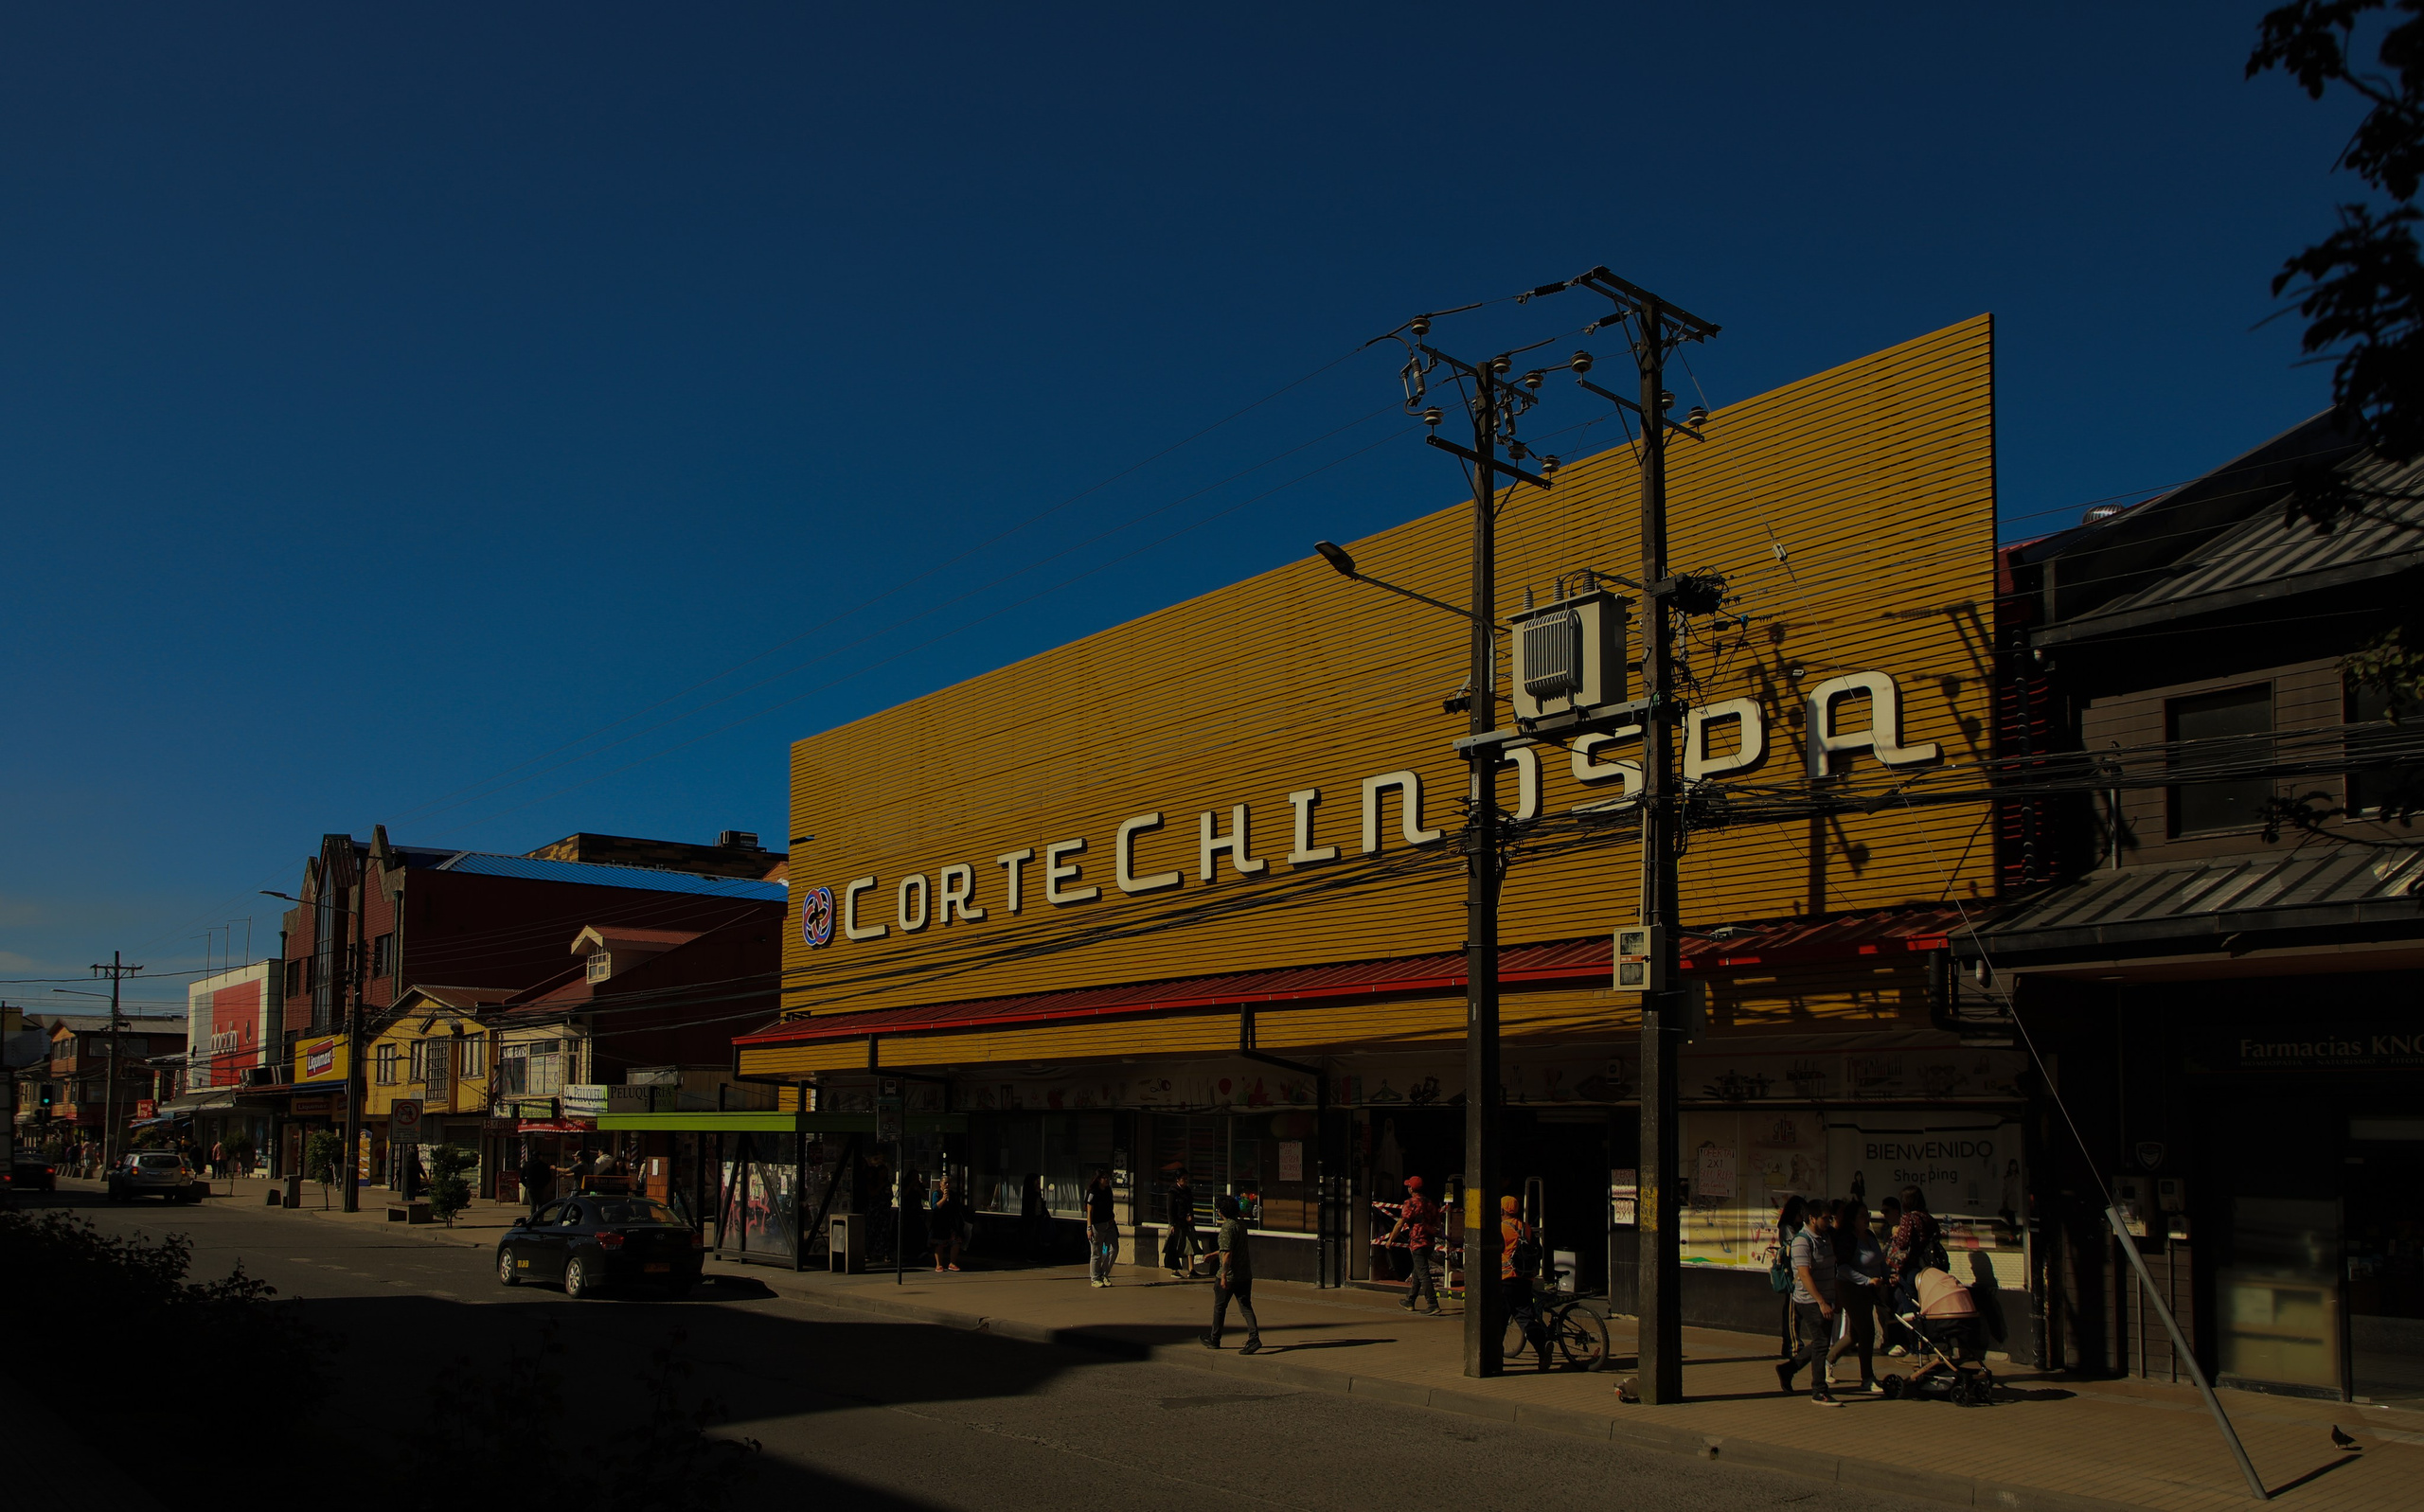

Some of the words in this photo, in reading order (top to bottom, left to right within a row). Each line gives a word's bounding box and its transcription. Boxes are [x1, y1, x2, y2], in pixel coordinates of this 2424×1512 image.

[845, 838, 1101, 941] CORTE
[1571, 669, 1942, 815] SPA
[2239, 1035, 2362, 1058] Farmacias
[611, 1086, 672, 1100] PELUQURIA
[1866, 1141, 1993, 1160] BIENVENIDO
[1894, 1167, 1957, 1184] Shopping
